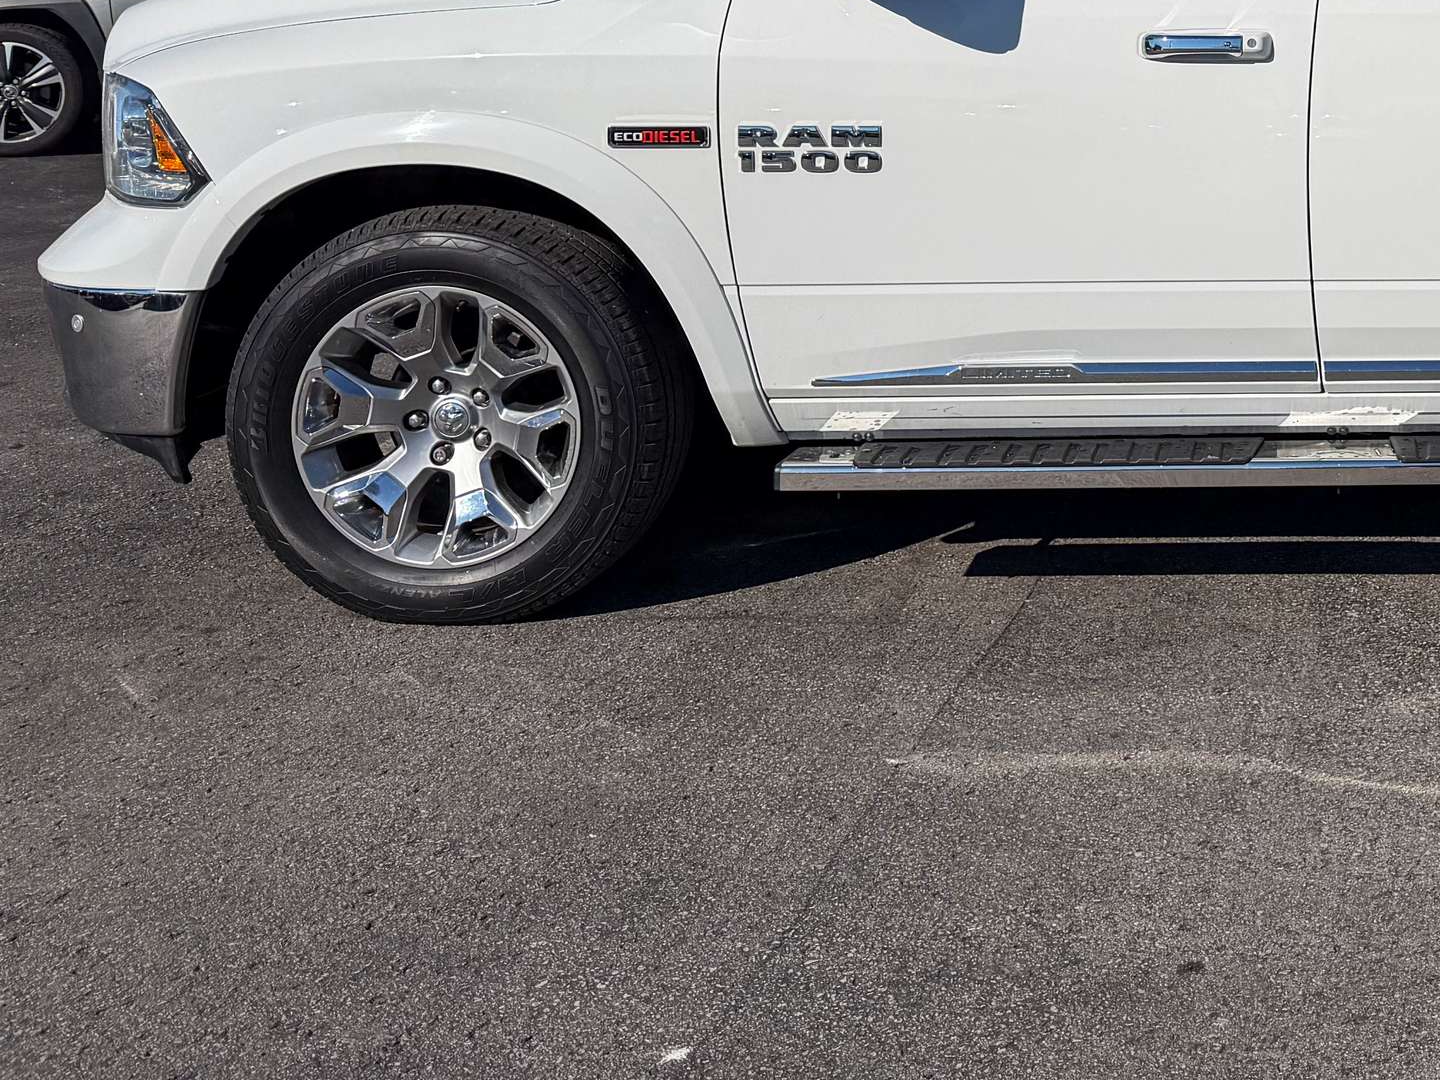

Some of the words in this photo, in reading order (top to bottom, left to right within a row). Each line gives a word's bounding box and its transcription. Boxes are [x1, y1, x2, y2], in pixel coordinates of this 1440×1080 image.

[613, 130, 700, 144] ECODIESEL
[737, 125, 883, 148] RAM
[738, 150, 883, 173] 1500
[249, 254, 398, 452] DGESTONE
